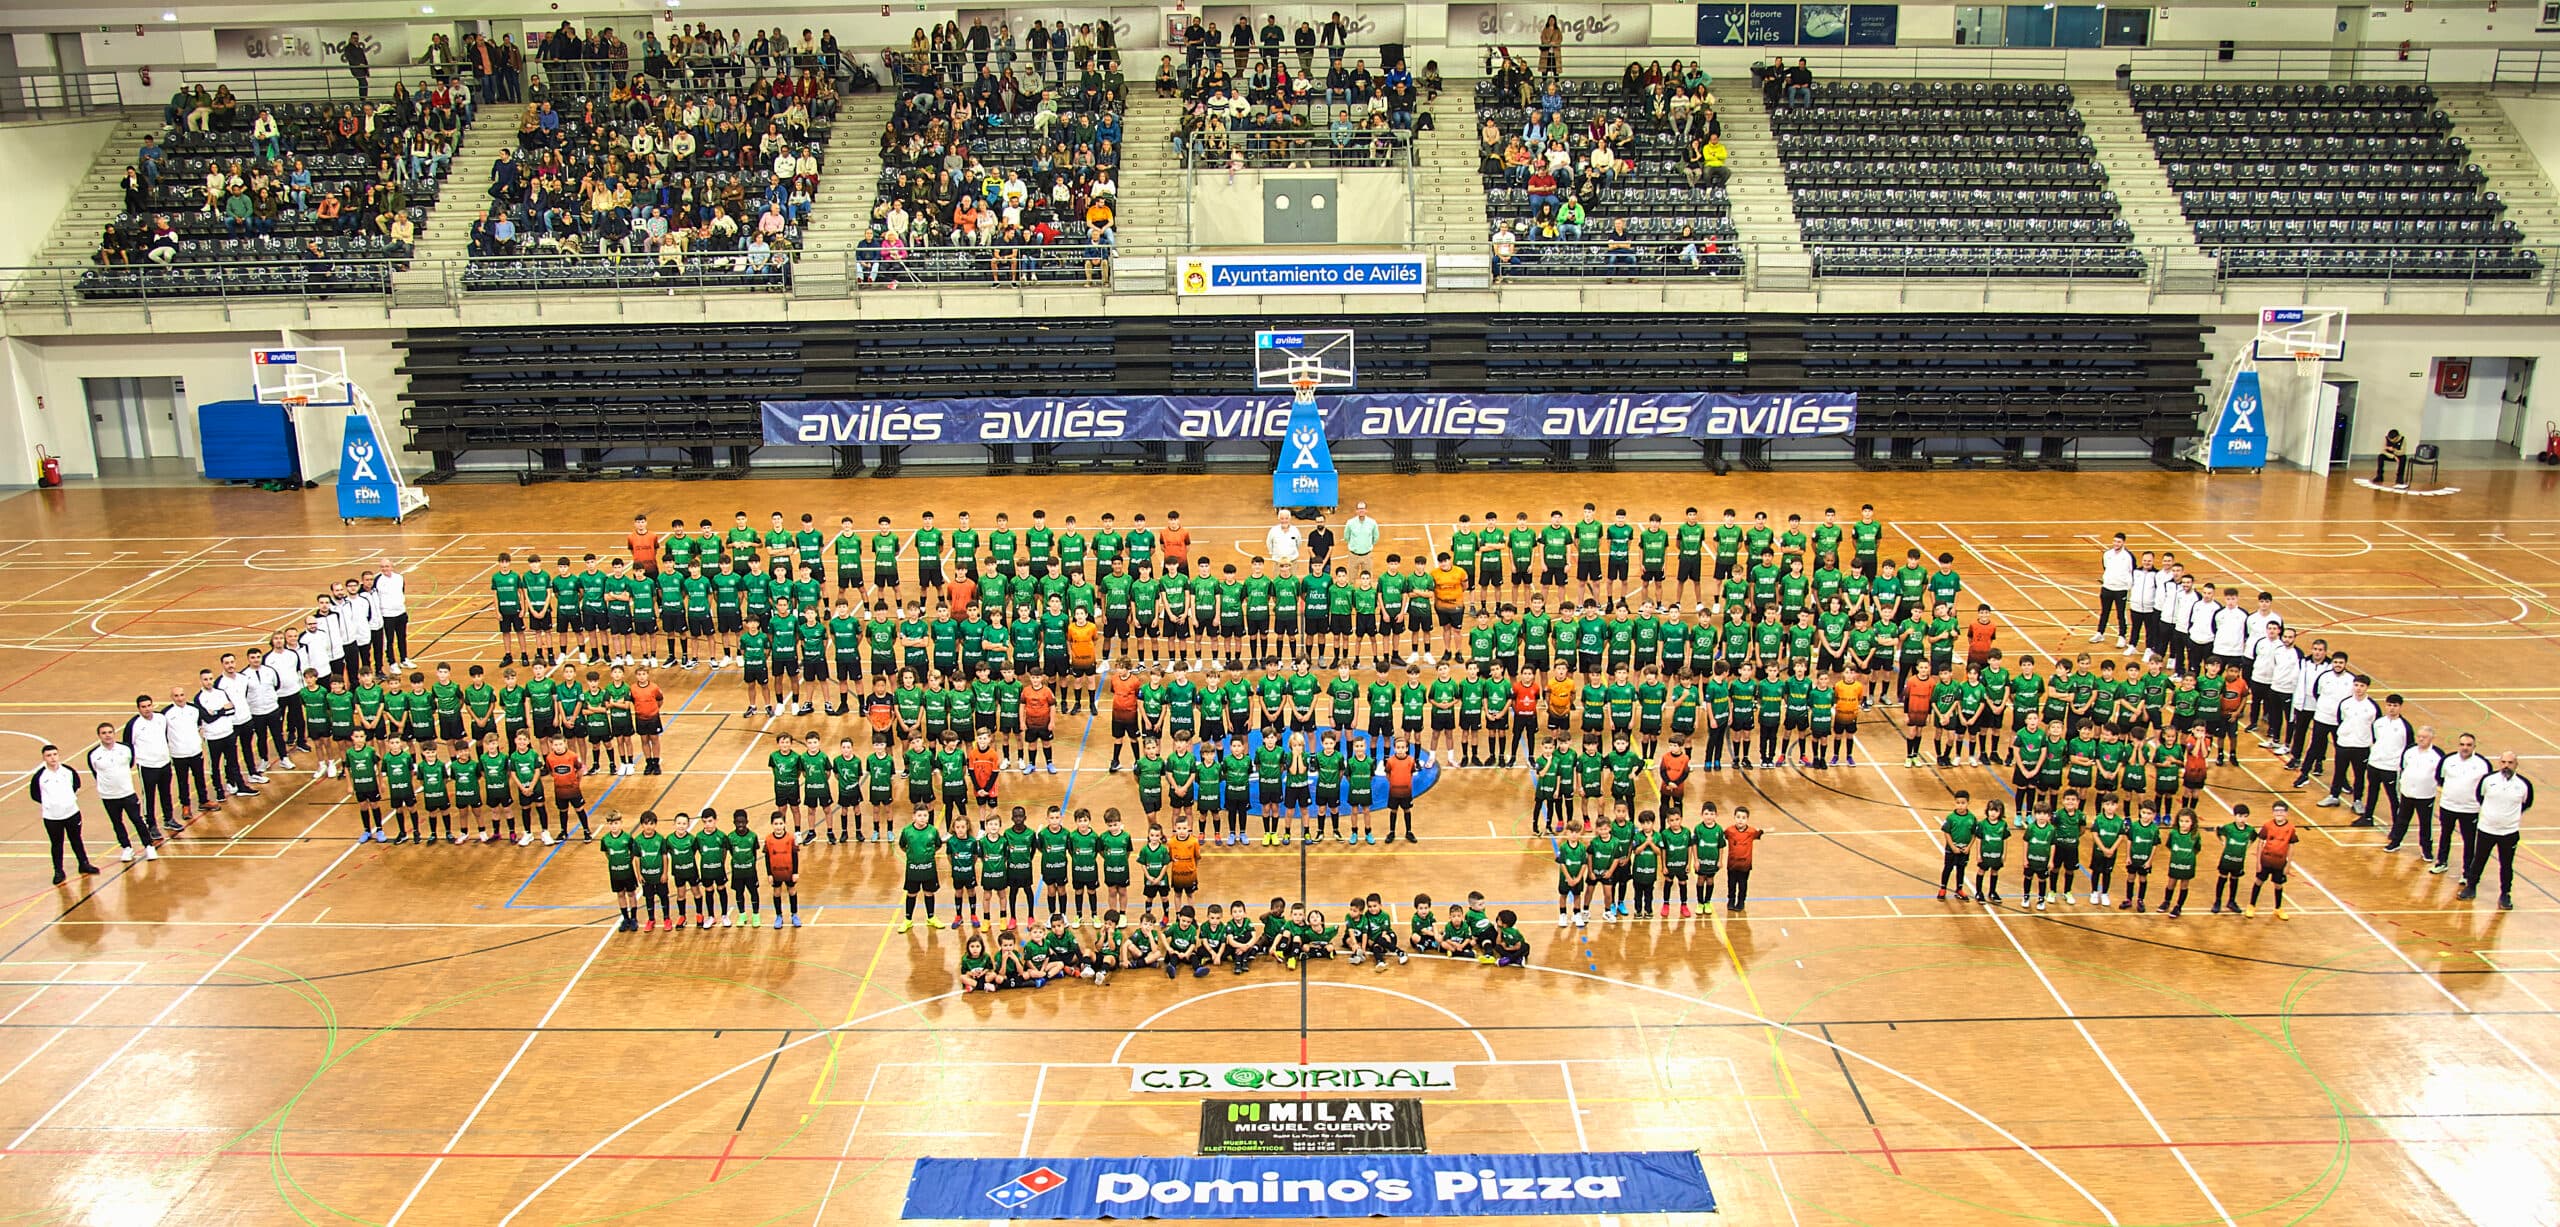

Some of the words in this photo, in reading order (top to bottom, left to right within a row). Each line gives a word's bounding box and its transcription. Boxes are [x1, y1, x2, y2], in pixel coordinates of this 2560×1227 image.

[1750, 10, 1782, 19] deporte
[1217, 266, 1338, 286] Ayuntamiento
[1343, 265, 1364, 282] de
[1369, 264, 1417, 281] Avilés
[2264, 311, 2272, 322] 6
[1260, 336, 1269, 346] 4
[258, 352, 265, 364] 2
[798, 406, 944, 442] avilés
[979, 402, 1128, 440] avilés
[1361, 398, 1509, 436] avilés
[1541, 398, 1691, 436] avilés
[1706, 398, 1854, 435] avilés
[2228, 441, 2252, 450] FDM
[1292, 478, 1319, 488] FDM
[354, 488, 380, 498] FDM
[1224, 1067, 1451, 1089] QUIRINAL
[1268, 1102, 1395, 1122] MILAR
[1235, 1123, 1308, 1132] MIGUEL
[1314, 1122, 1392, 1132] CUERVO
[1096, 1170, 1413, 1204] Domino's
[1434, 1169, 1621, 1201] Pizza
